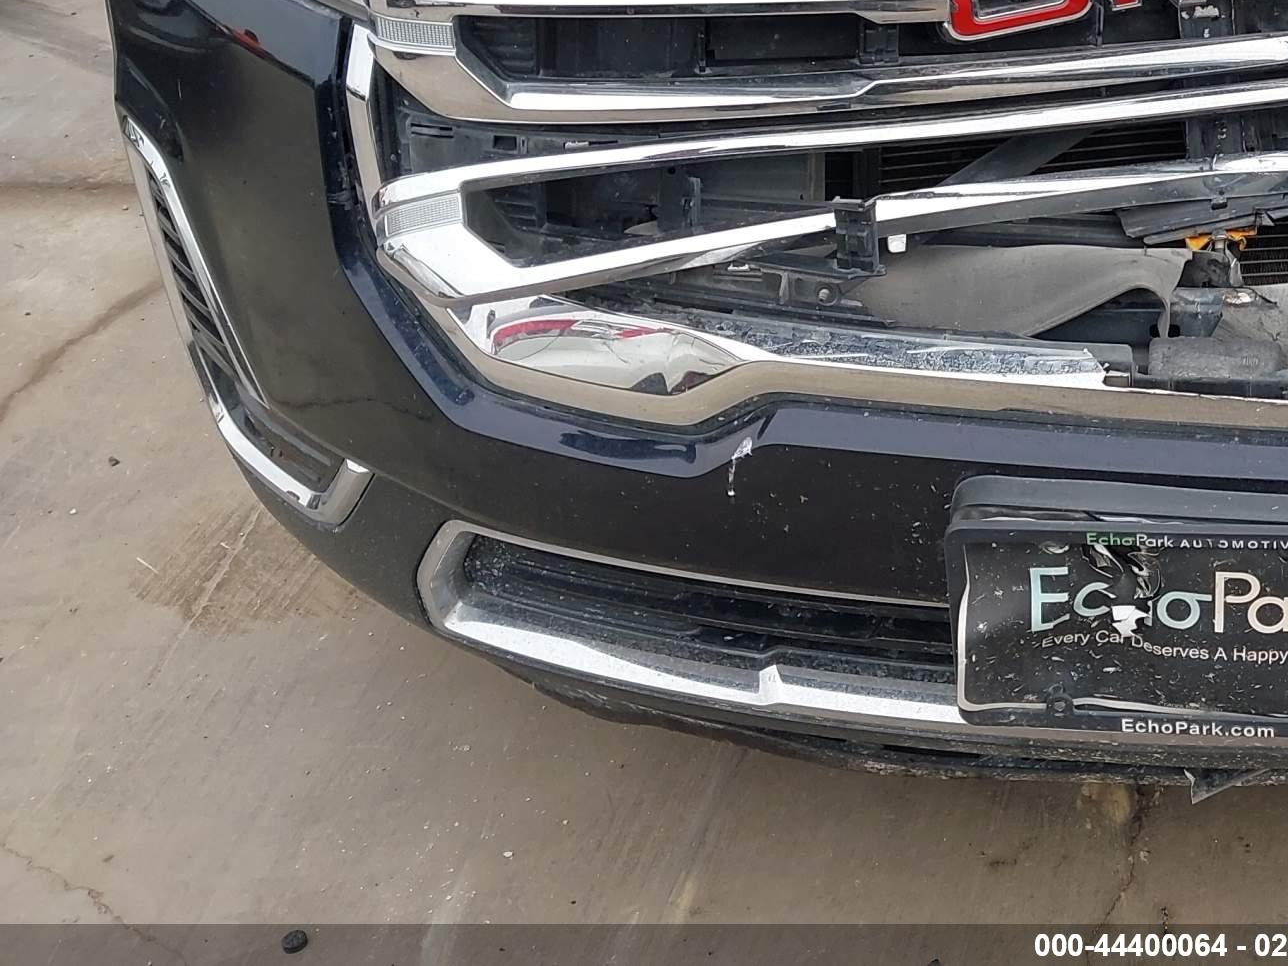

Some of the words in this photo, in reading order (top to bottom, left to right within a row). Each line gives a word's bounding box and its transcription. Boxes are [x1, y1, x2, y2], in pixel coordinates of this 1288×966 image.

[1086, 532, 1174, 548] EchoPark
[1042, 631, 1091, 648] Every
[1131, 634, 1209, 660] Deserves
[1213, 647, 1228, 662] A
[1121, 718, 1275, 738] EchoPark.com
